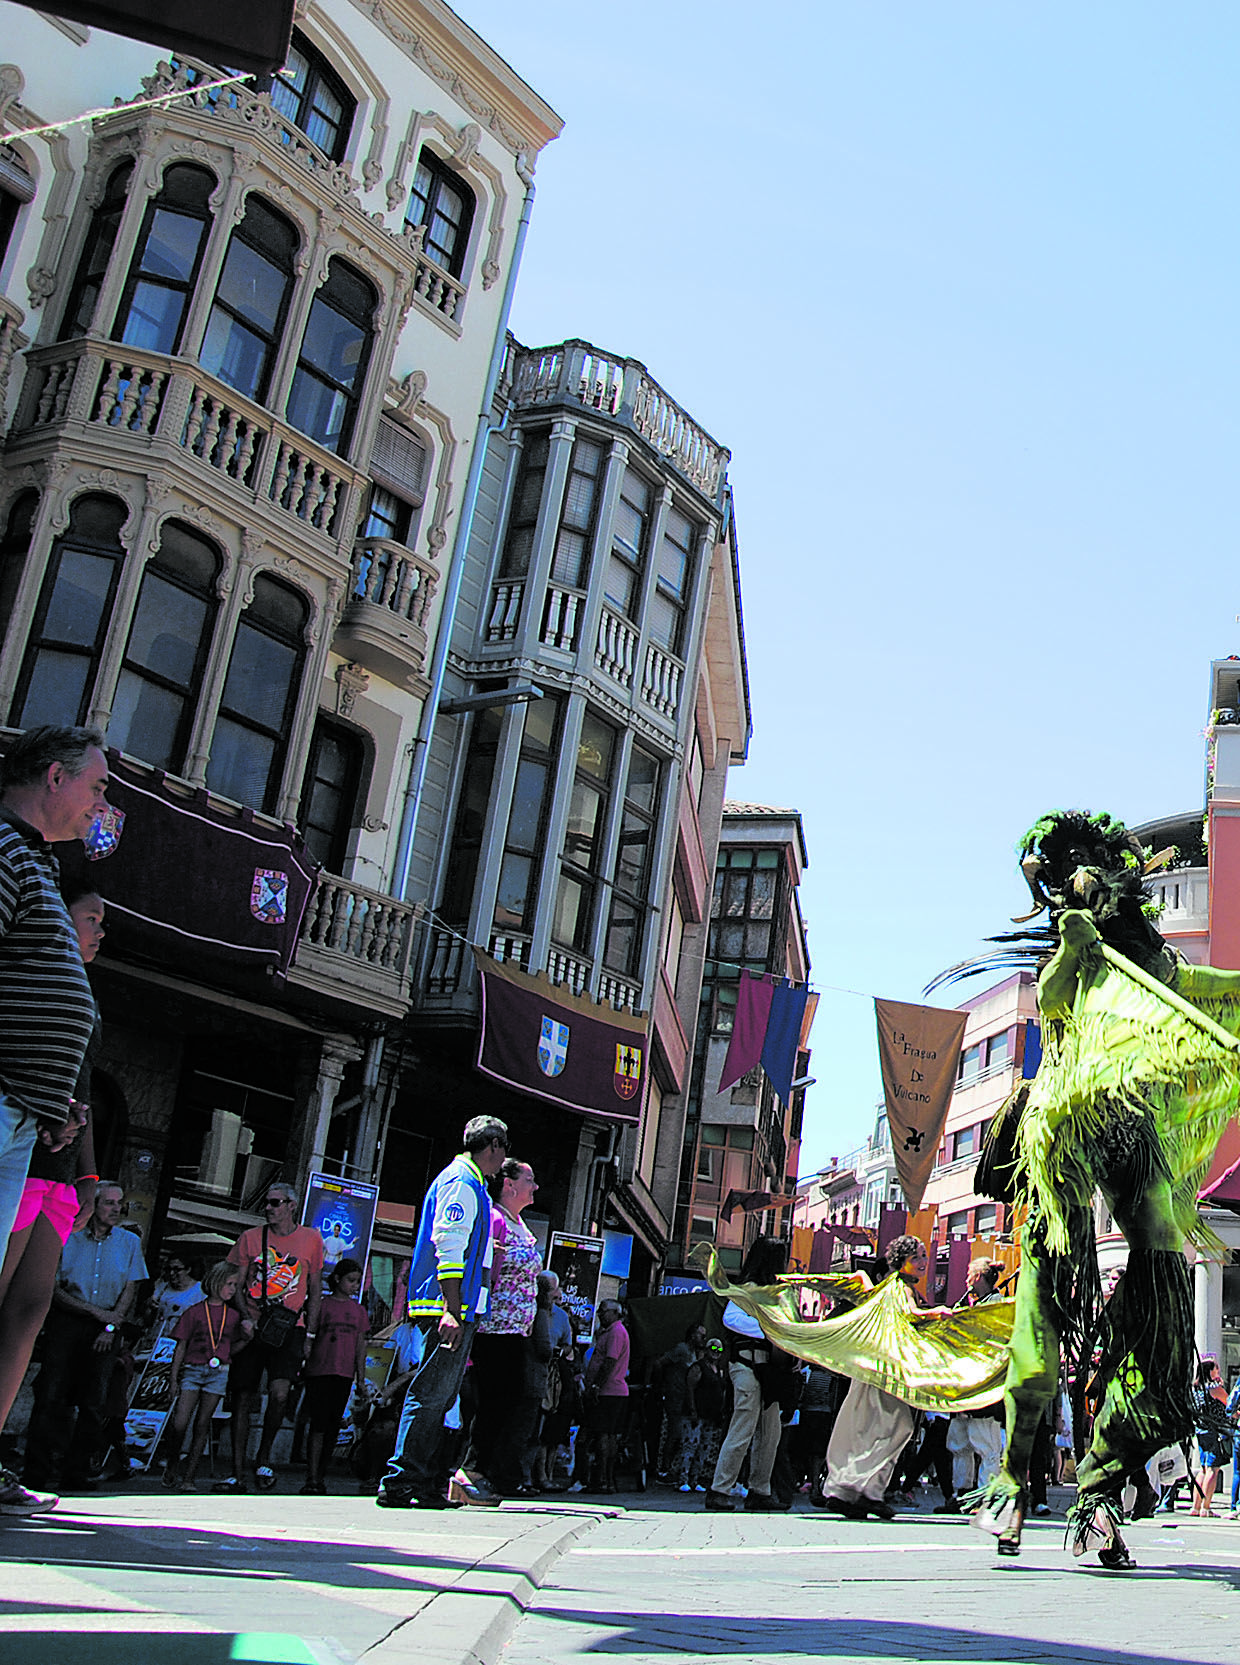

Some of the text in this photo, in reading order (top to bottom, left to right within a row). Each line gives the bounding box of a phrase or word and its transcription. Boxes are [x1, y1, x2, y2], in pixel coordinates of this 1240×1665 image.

[893, 1031, 937, 1060] La Fragua
[892, 1083, 931, 1104] Vulcano
[659, 1285, 689, 1296] anco
